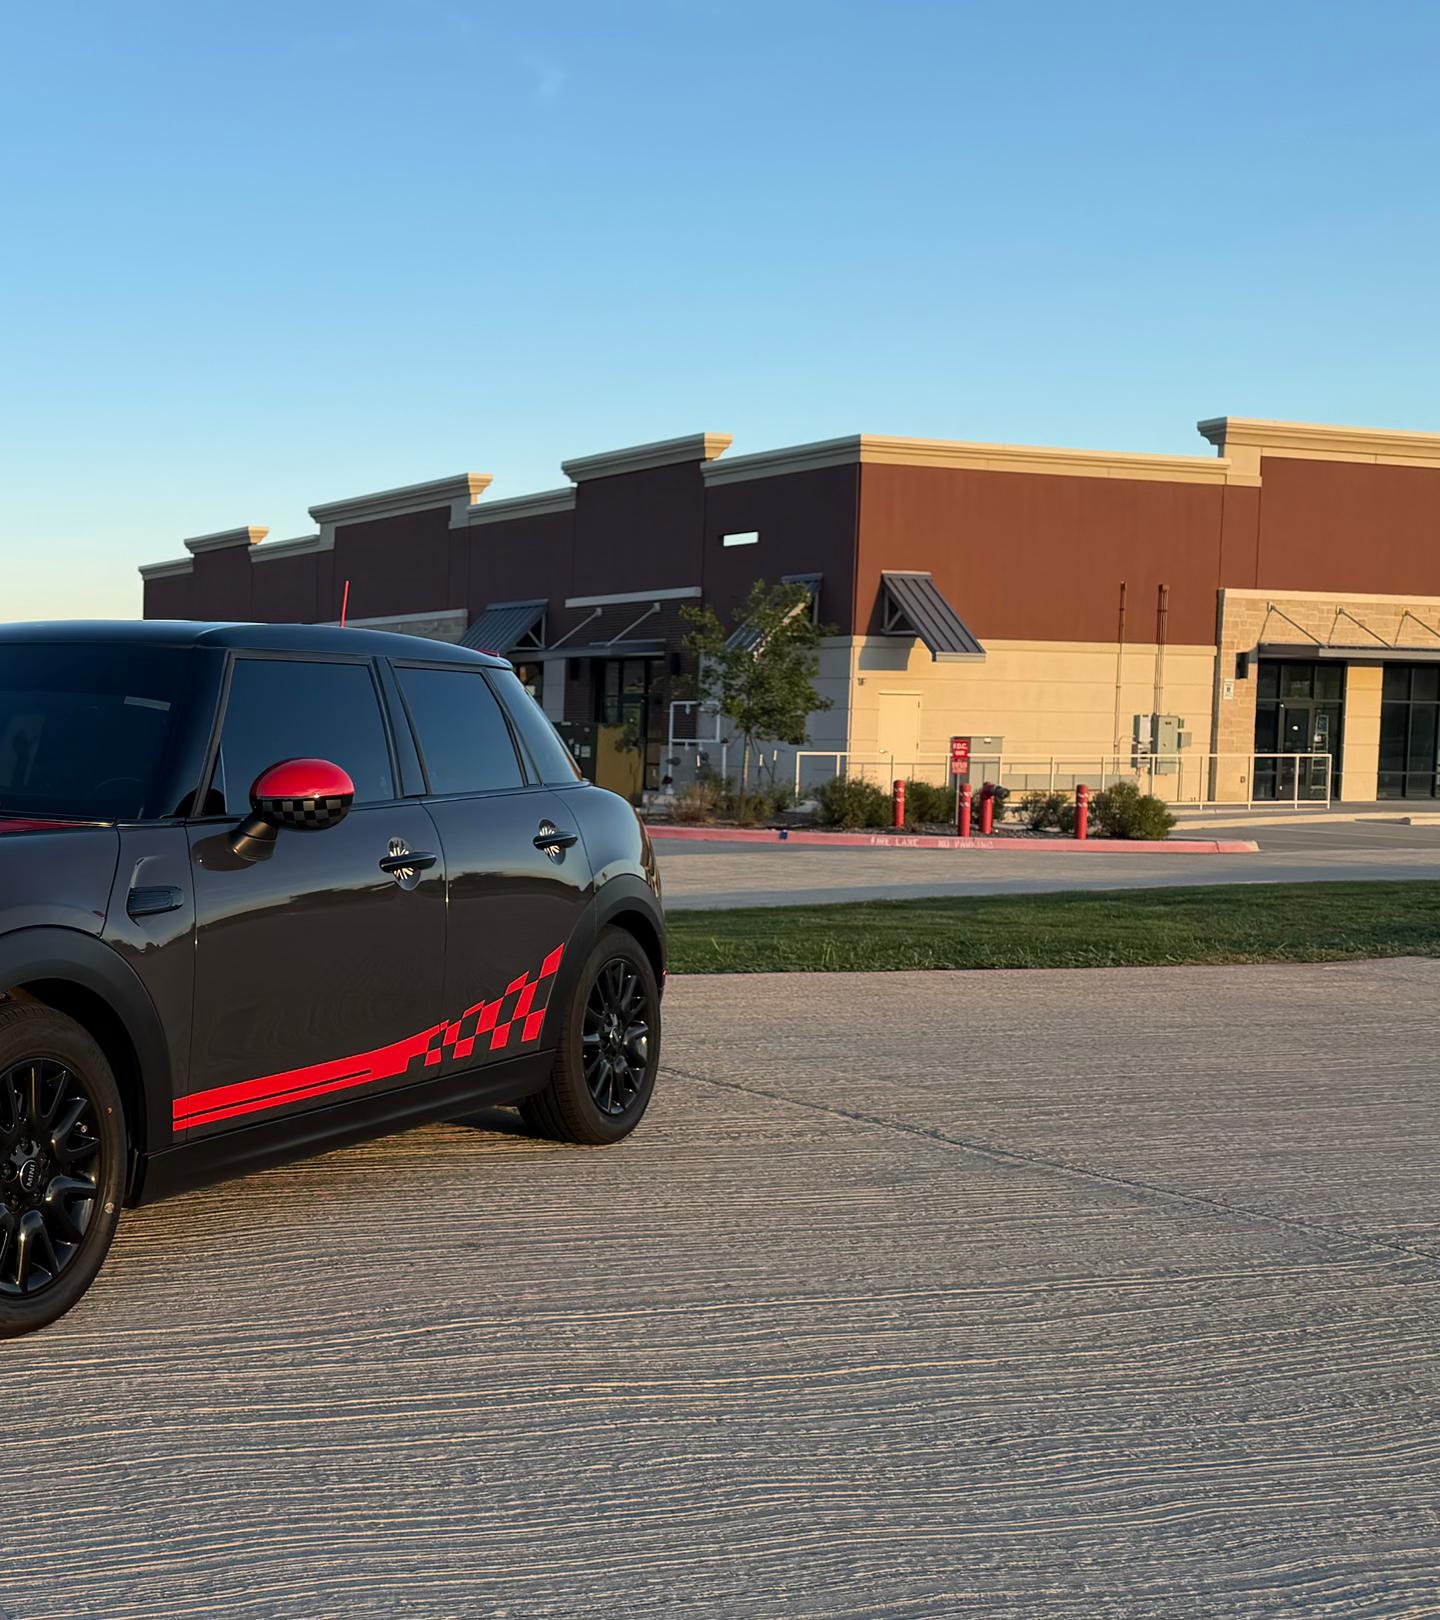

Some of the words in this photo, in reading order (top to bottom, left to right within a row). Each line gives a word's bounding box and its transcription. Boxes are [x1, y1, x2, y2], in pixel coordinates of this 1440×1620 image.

[895, 838, 920, 848] LANE
[938, 839, 950, 848] NO
[954, 840, 994, 849] PARKING
[26, 1164, 36, 1187] MINI
